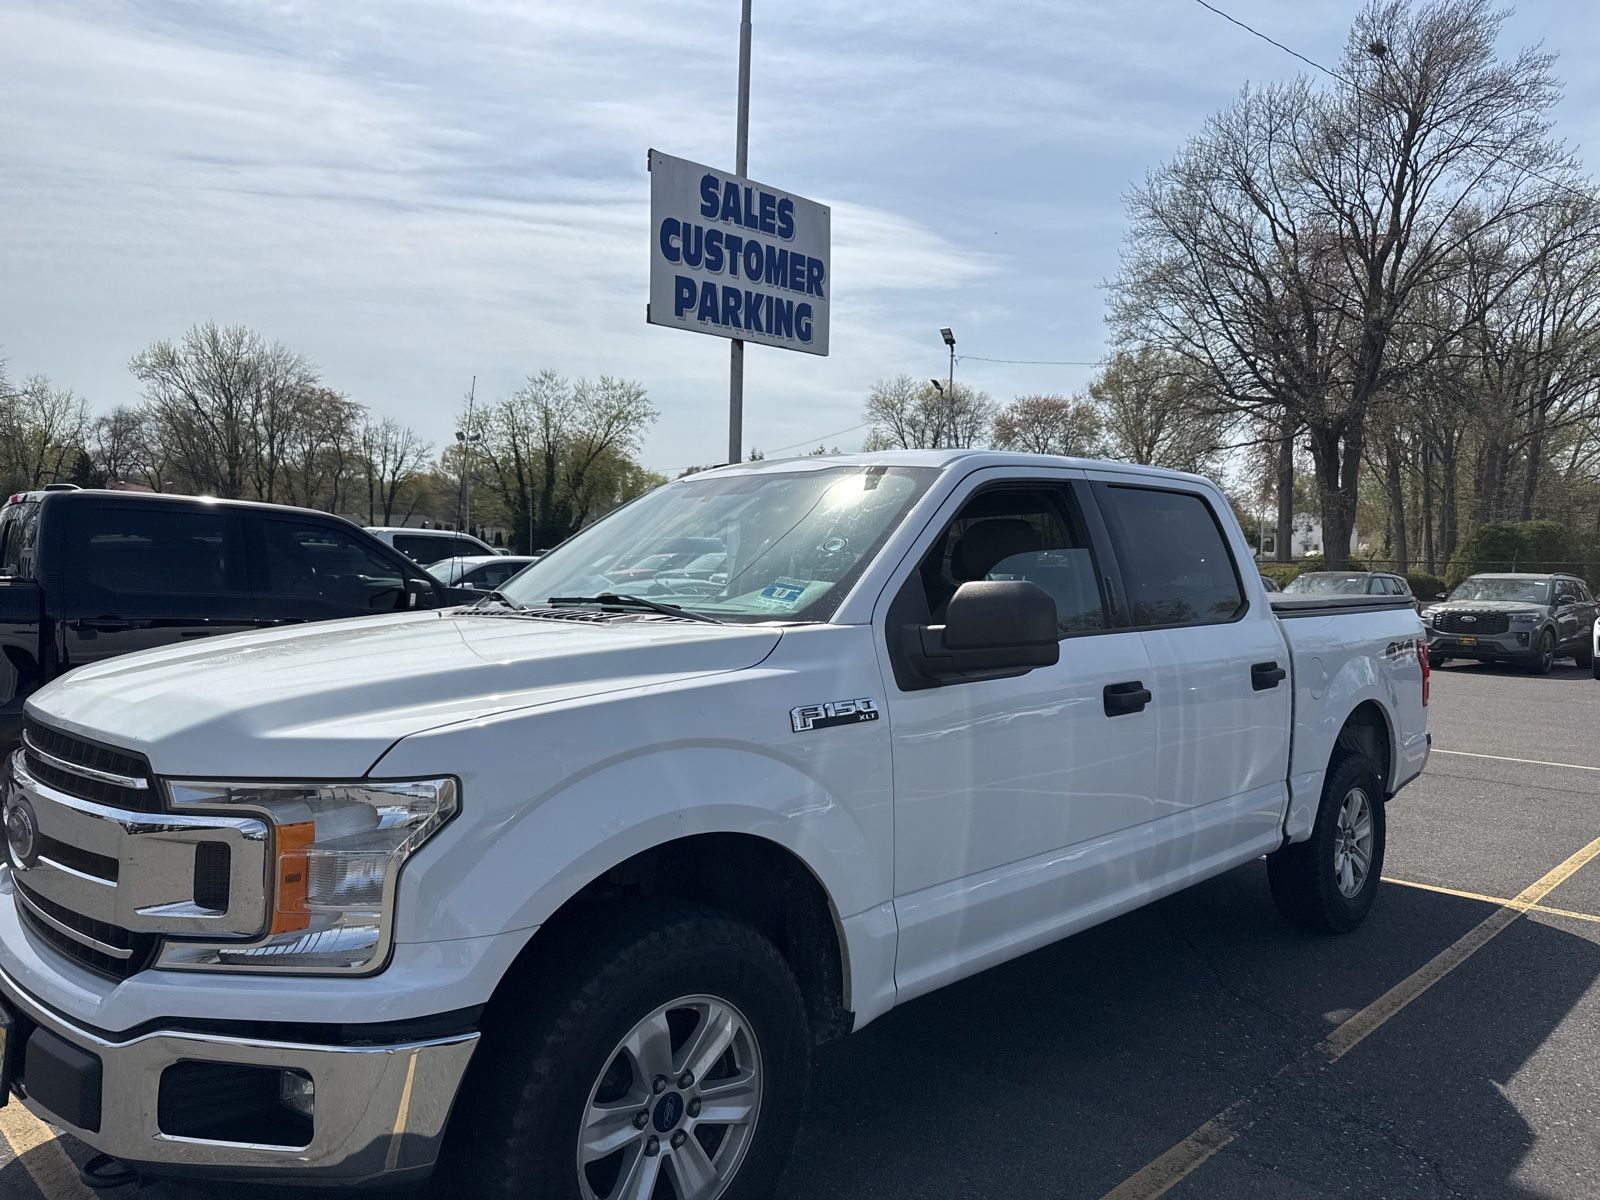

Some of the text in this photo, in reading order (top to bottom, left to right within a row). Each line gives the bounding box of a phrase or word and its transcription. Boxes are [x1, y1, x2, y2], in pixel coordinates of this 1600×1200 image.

[700, 173, 794, 239] SALES
[660, 217, 825, 298] CUSTOMER
[675, 275, 812, 342] PARKING
[859, 713, 875, 721] XLT
